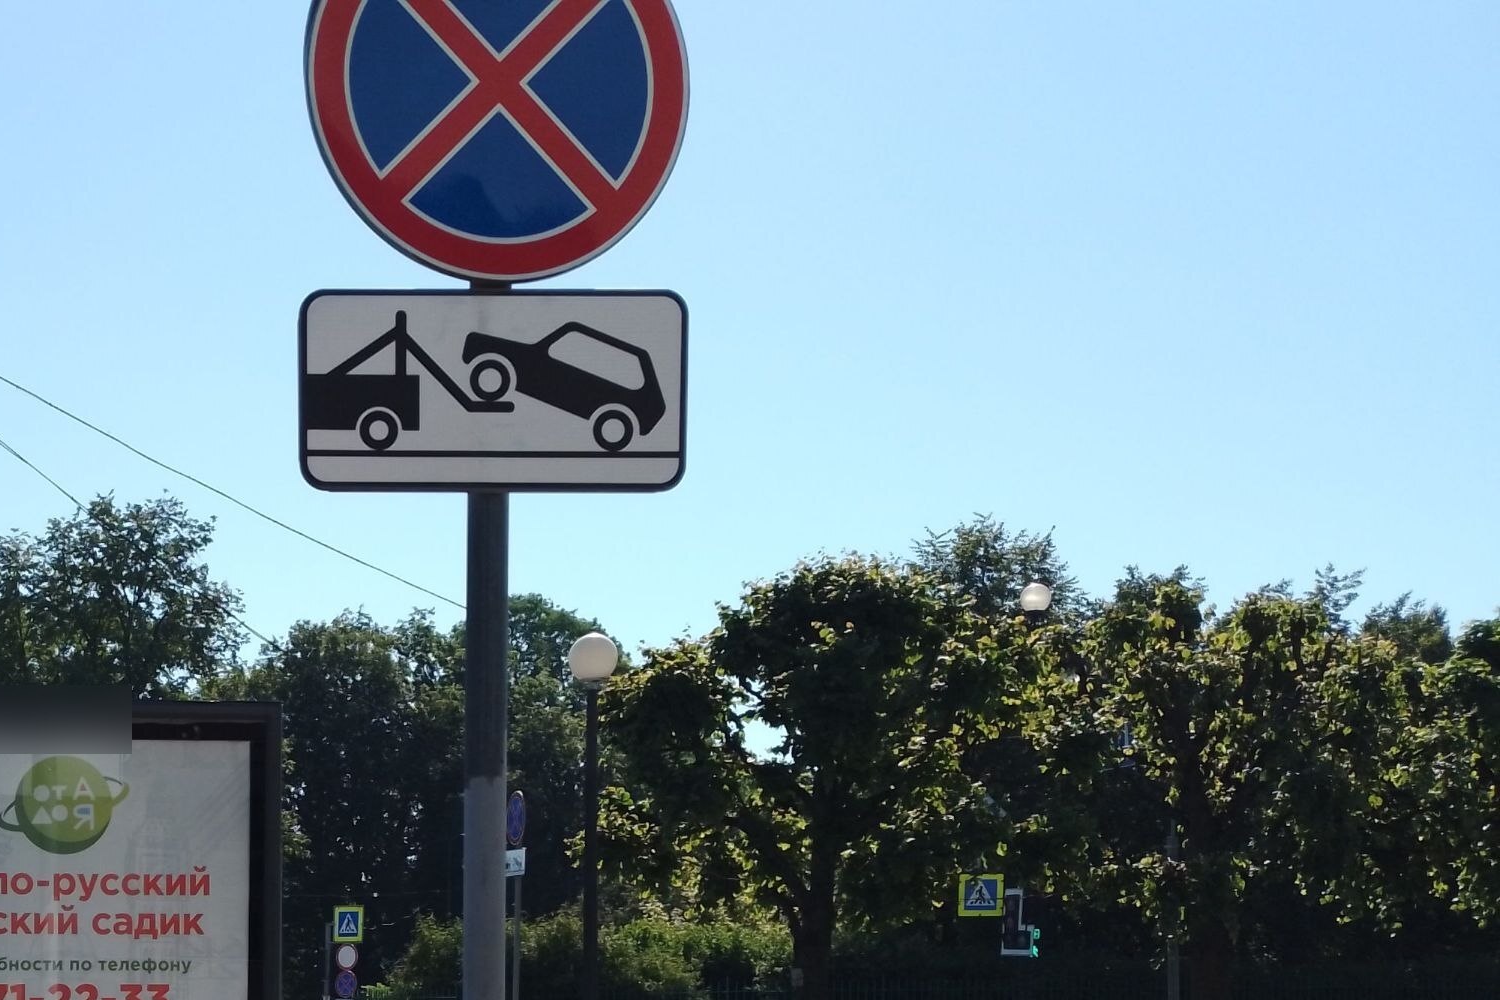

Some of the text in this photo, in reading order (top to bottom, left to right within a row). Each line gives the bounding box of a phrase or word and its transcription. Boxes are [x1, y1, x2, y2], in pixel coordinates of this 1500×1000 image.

[92, 908, 204, 940] садик
[69, 960, 92, 973] по
[98, 956, 192, 975] телефону
